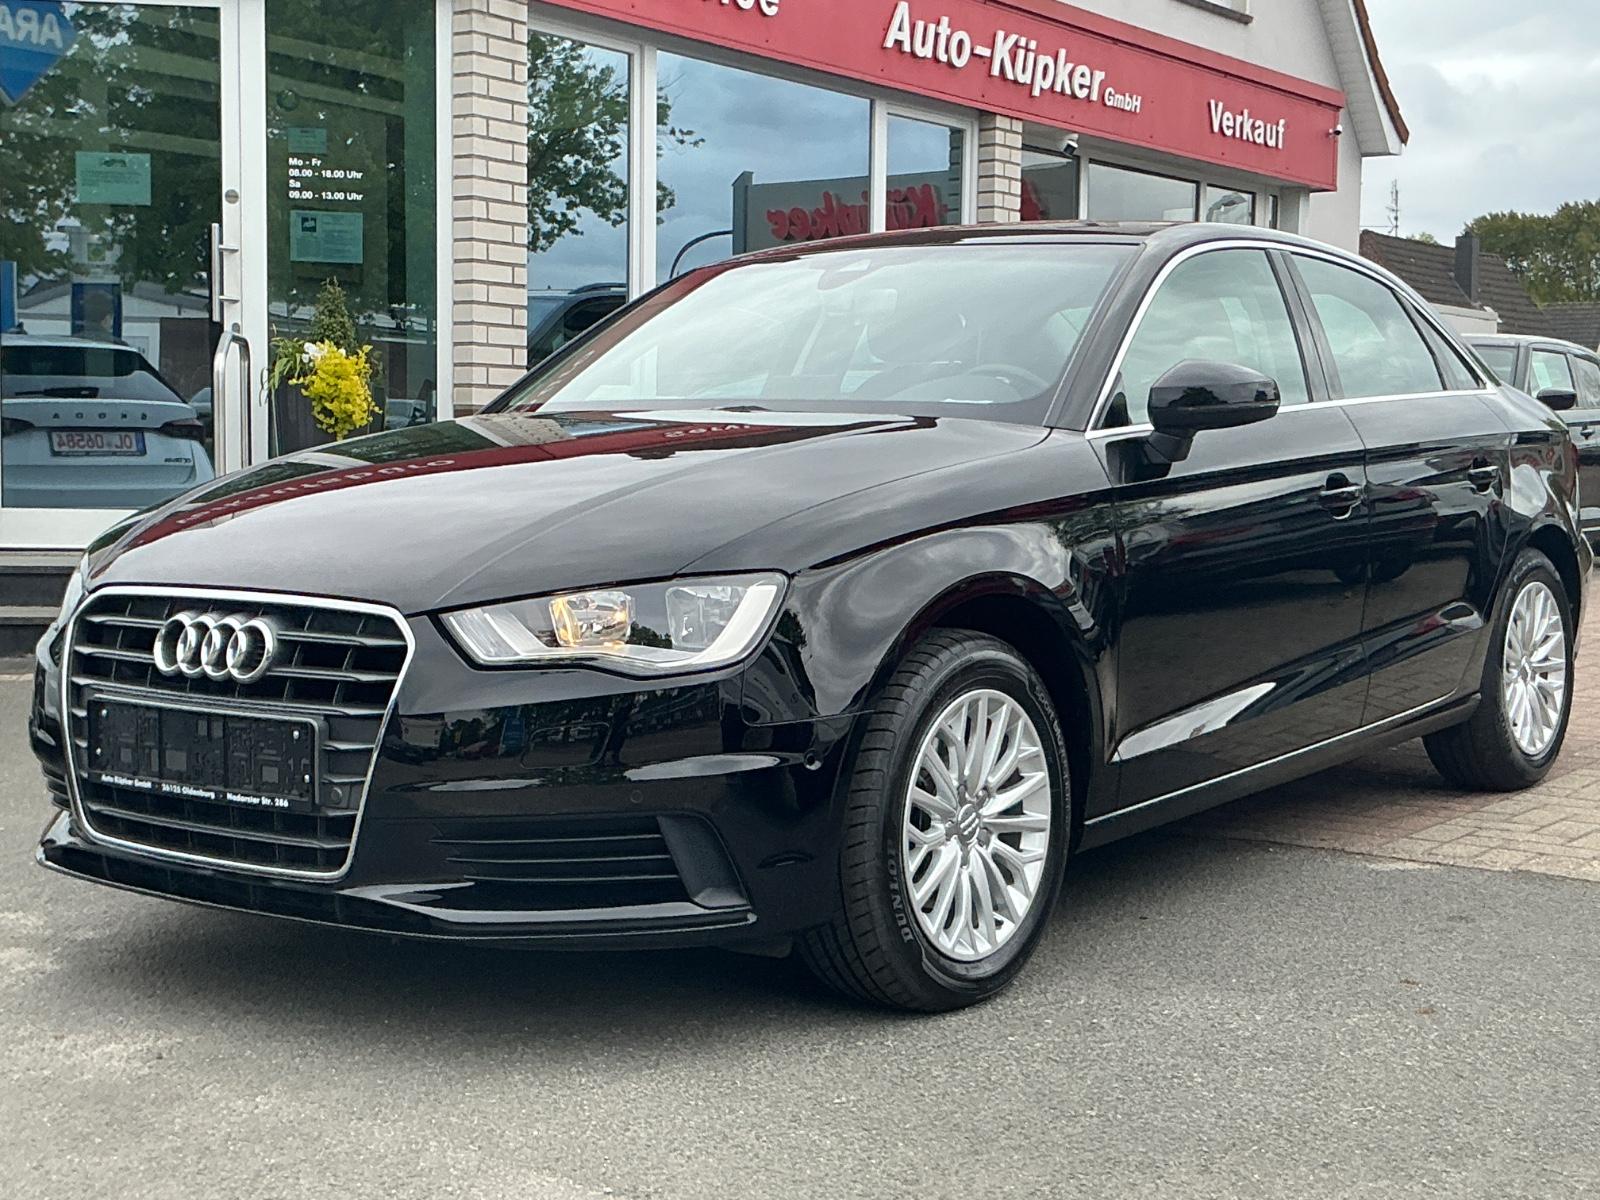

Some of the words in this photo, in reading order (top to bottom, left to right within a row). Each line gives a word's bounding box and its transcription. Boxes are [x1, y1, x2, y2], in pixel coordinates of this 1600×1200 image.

[883, 1, 1105, 102] Auto-Küpker
[1104, 86, 1142, 114] GmbH
[1209, 99, 1286, 149] Verkauf
[288, 157, 303, 166] Mo
[311, 158, 321, 166] Fr
[288, 168, 312, 177] 08.00
[321, 170, 345, 178] 18.00
[346, 170, 363, 179] Uhr
[288, 179, 301, 188] Sa
[288, 191, 313, 199] 09.00
[321, 192, 345, 200] 13.00
[346, 192, 363, 200] Uhr
[274, 797, 288, 807] 286
